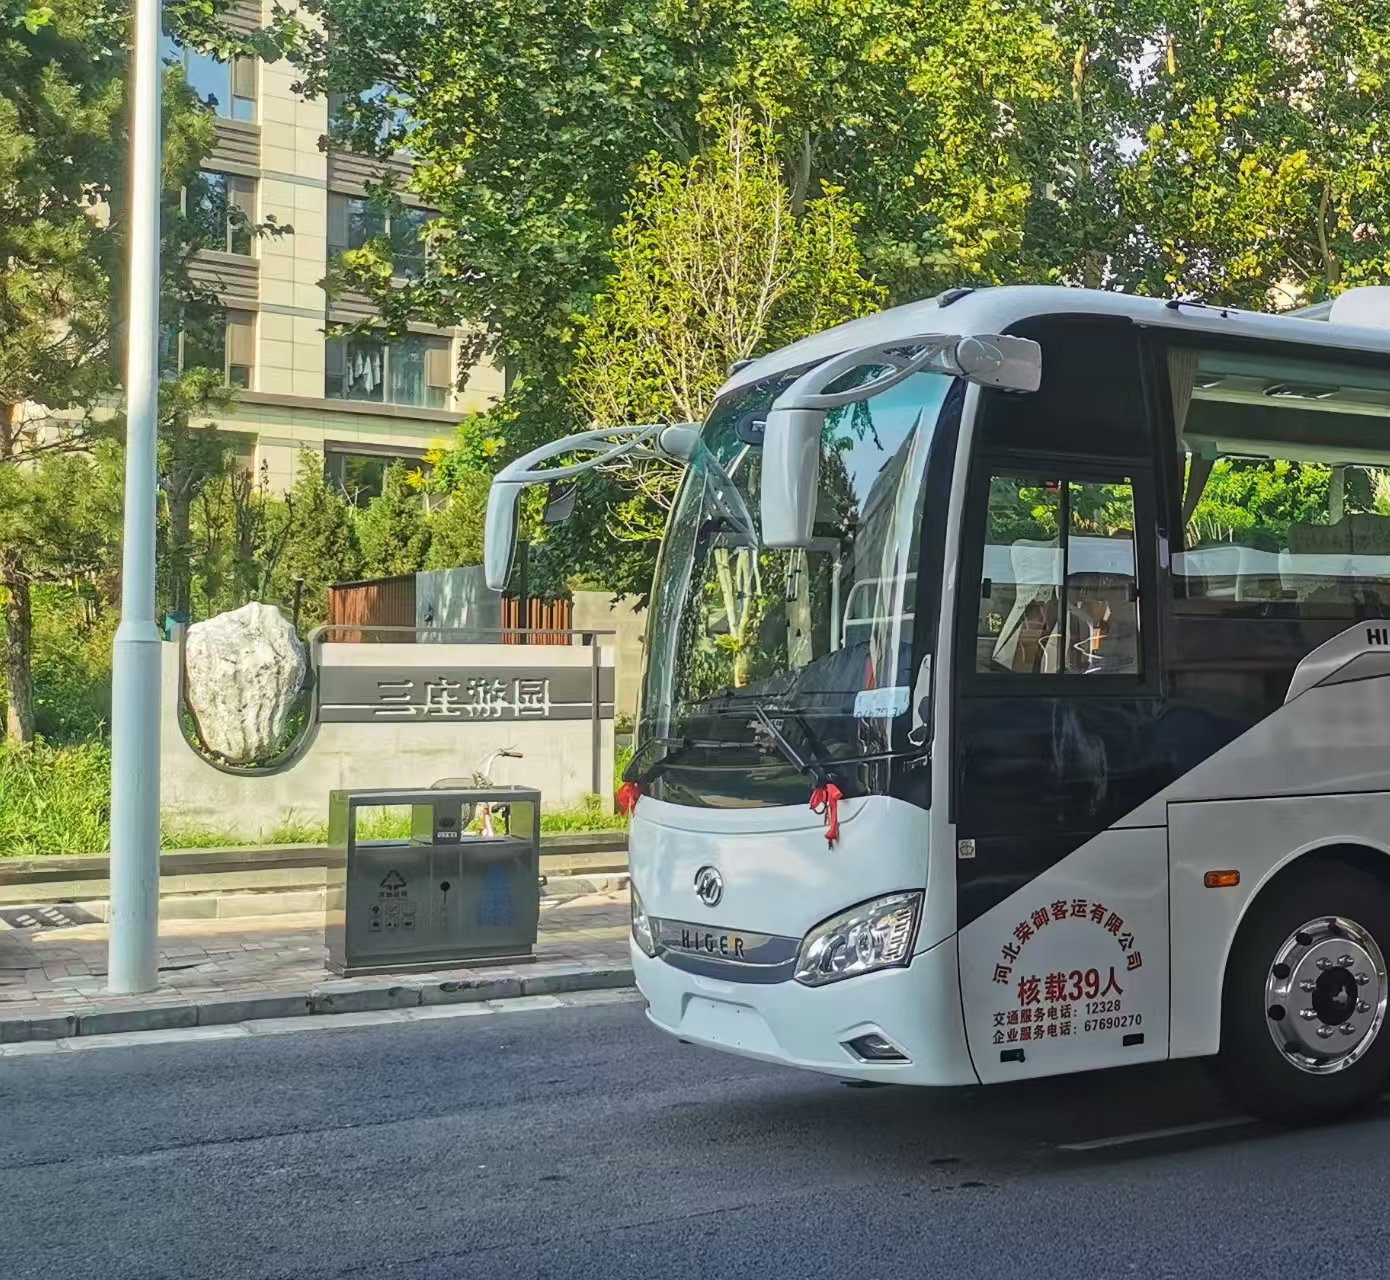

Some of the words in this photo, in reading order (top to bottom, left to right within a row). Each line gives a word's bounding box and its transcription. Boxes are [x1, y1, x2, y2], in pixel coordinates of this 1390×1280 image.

[374, 676, 550, 718] 三庄游园
[682, 929, 745, 958] HIGER
[992, 899, 1143, 985] 河北荣御客运有限公司
[1017, 966, 1124, 1007] 核载39人
